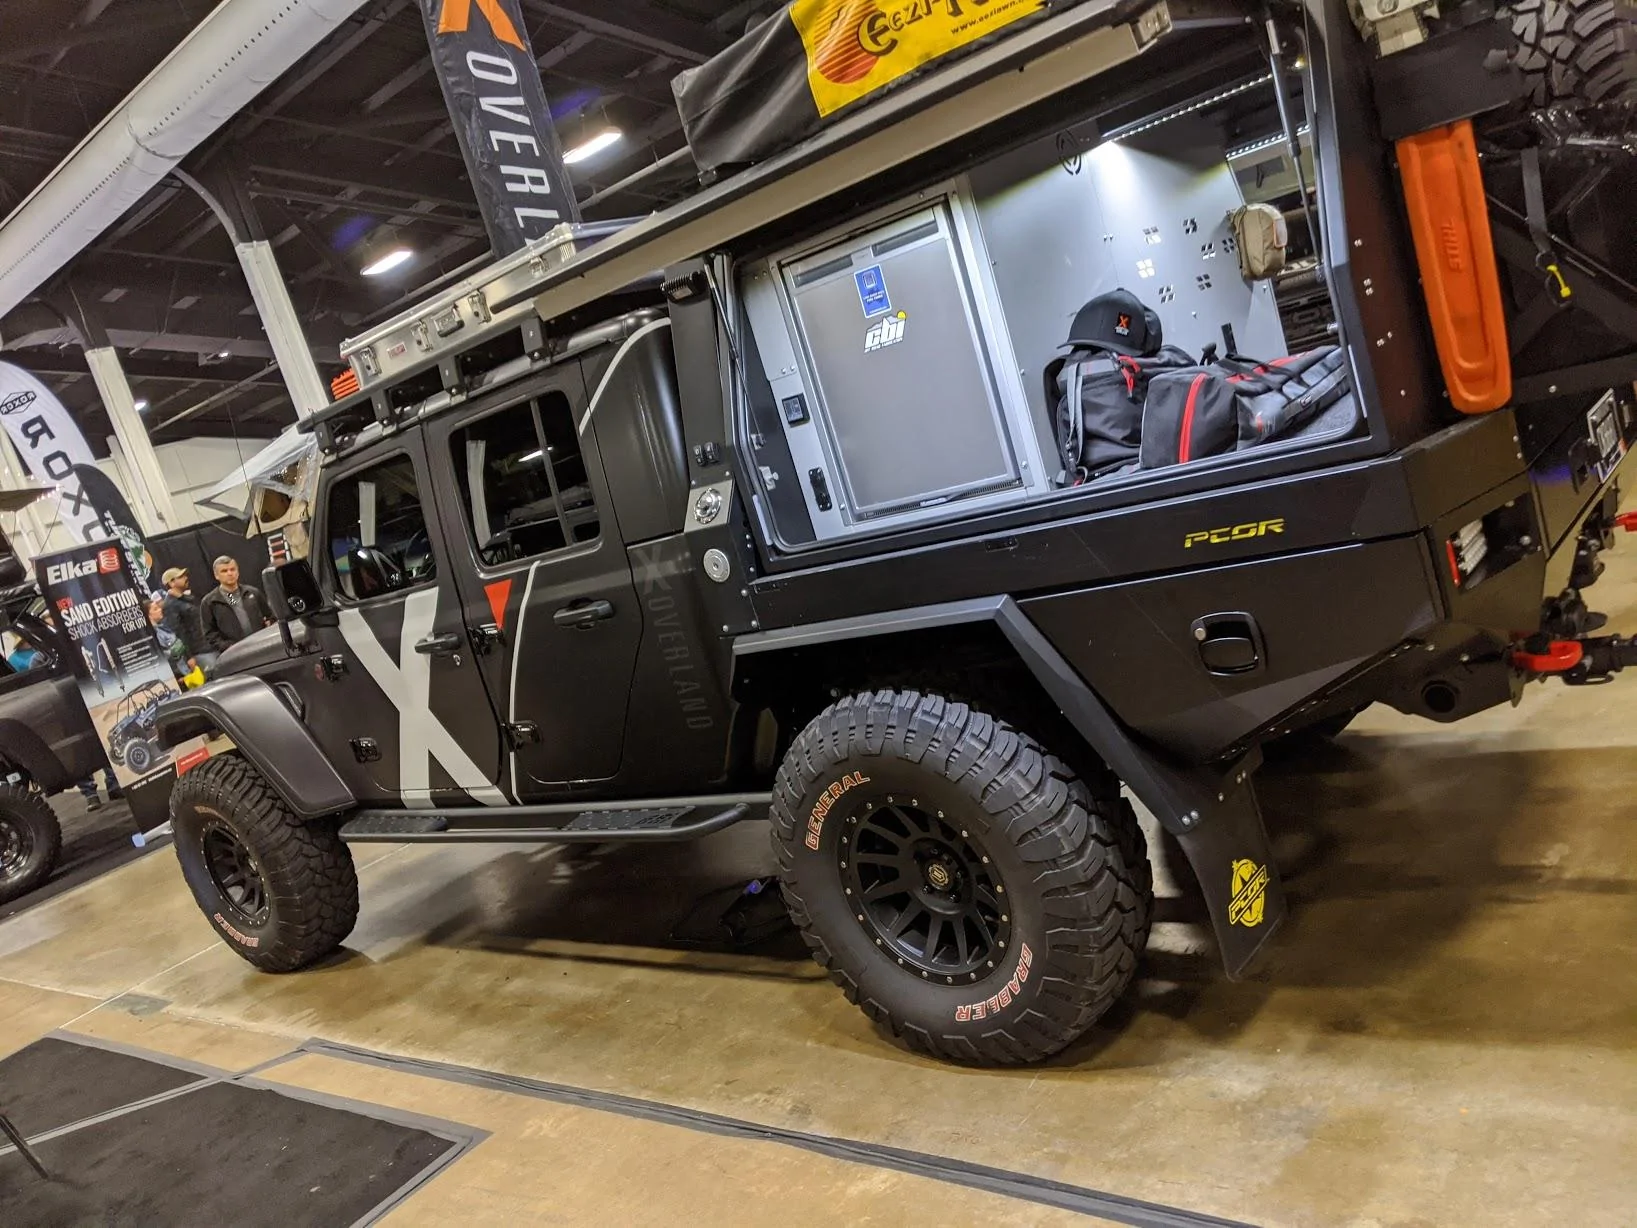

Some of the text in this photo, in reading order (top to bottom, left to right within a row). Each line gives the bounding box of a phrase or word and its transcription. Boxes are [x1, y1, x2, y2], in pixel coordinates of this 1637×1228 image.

[466, 50, 560, 247] OVERL
[46, 558, 98, 586] Elka
[61, 588, 139, 627] SAND EDITION
[68, 605, 144, 641] SHOCK ABSORBERS
[122, 620, 137, 635] FOR
[649, 597, 714, 729] OVERLAND
[805, 770, 871, 850] GENERAL
[955, 943, 1033, 1022] GRABBER
